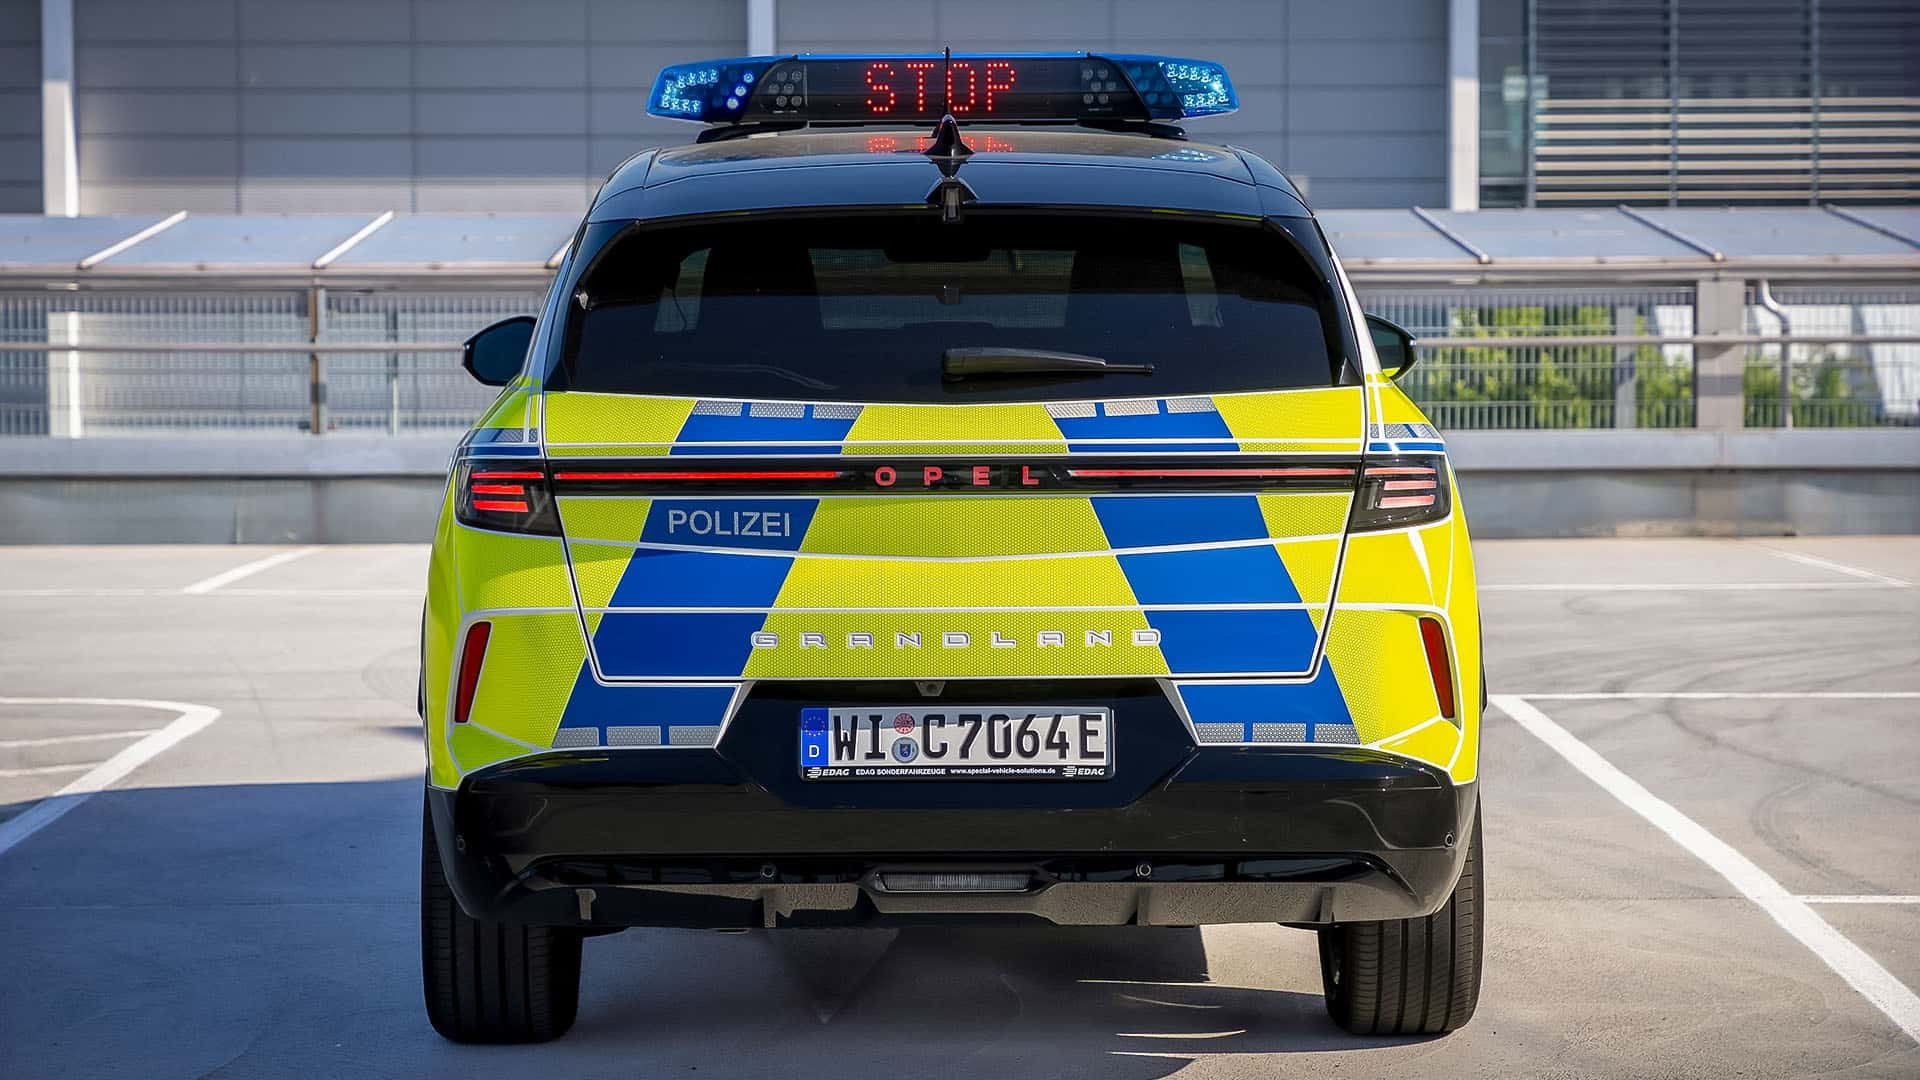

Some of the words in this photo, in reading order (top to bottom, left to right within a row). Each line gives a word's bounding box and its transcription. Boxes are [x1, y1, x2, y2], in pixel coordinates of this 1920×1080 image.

[865, 62, 1016, 112] STOP
[874, 466, 1040, 486] OPEL
[667, 509, 791, 537] POLIZEI
[751, 630, 1162, 648] GRANDLAND
[833, 714, 887, 761] WI
[808, 744, 820, 758] D
[822, 768, 850, 776] EDAG
[855, 768, 876, 776] EDAG
[876, 768, 946, 776] SONDERFAHRZEUGE
[950, 767, 1056, 776] www.special-vehicle-solutions.de
[1077, 767, 1105, 776] EDAG
